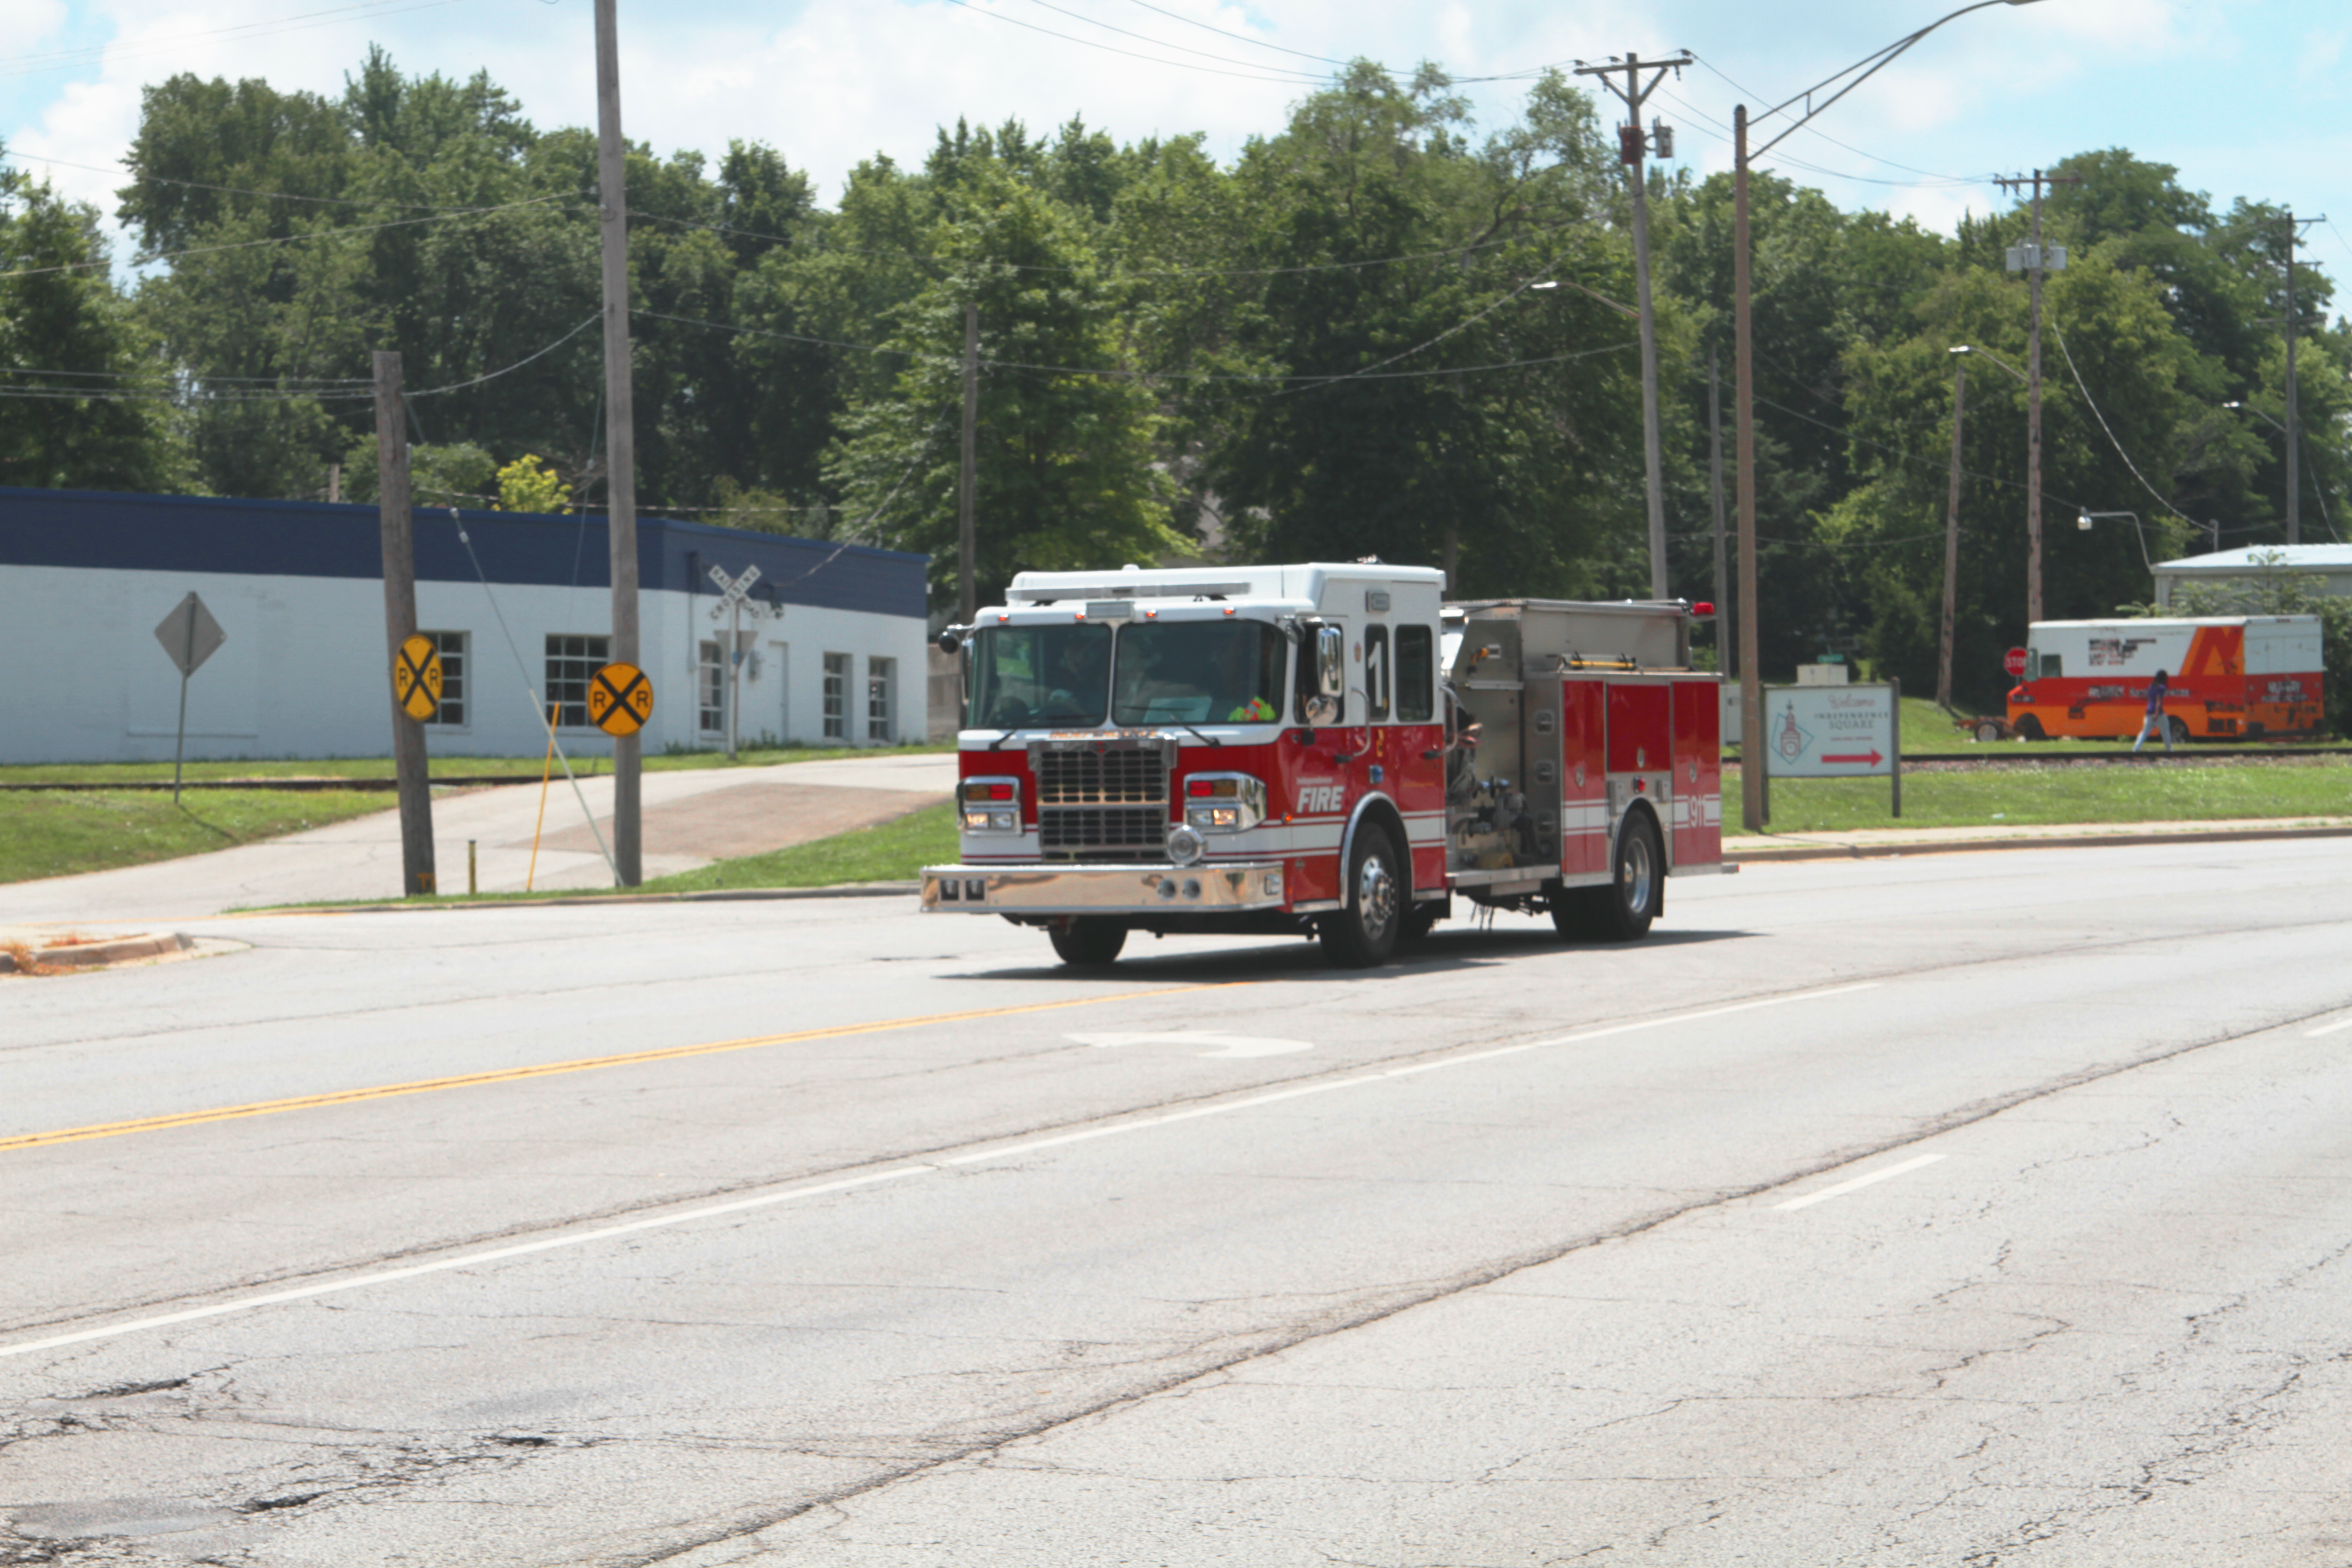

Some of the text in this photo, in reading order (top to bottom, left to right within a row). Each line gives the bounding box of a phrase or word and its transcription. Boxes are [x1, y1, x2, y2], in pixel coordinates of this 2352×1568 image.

[709, 568, 758, 620] CROSSING
[2005, 656, 2026, 668] STO
[398, 667, 440, 687] R R
[1367, 641, 1382, 708] 1
[593, 690, 649, 709] R R
[1829, 720, 1874, 731] SQUARE
[1296, 785, 1345, 813] FIRE
[1690, 795, 1706, 828] 911
